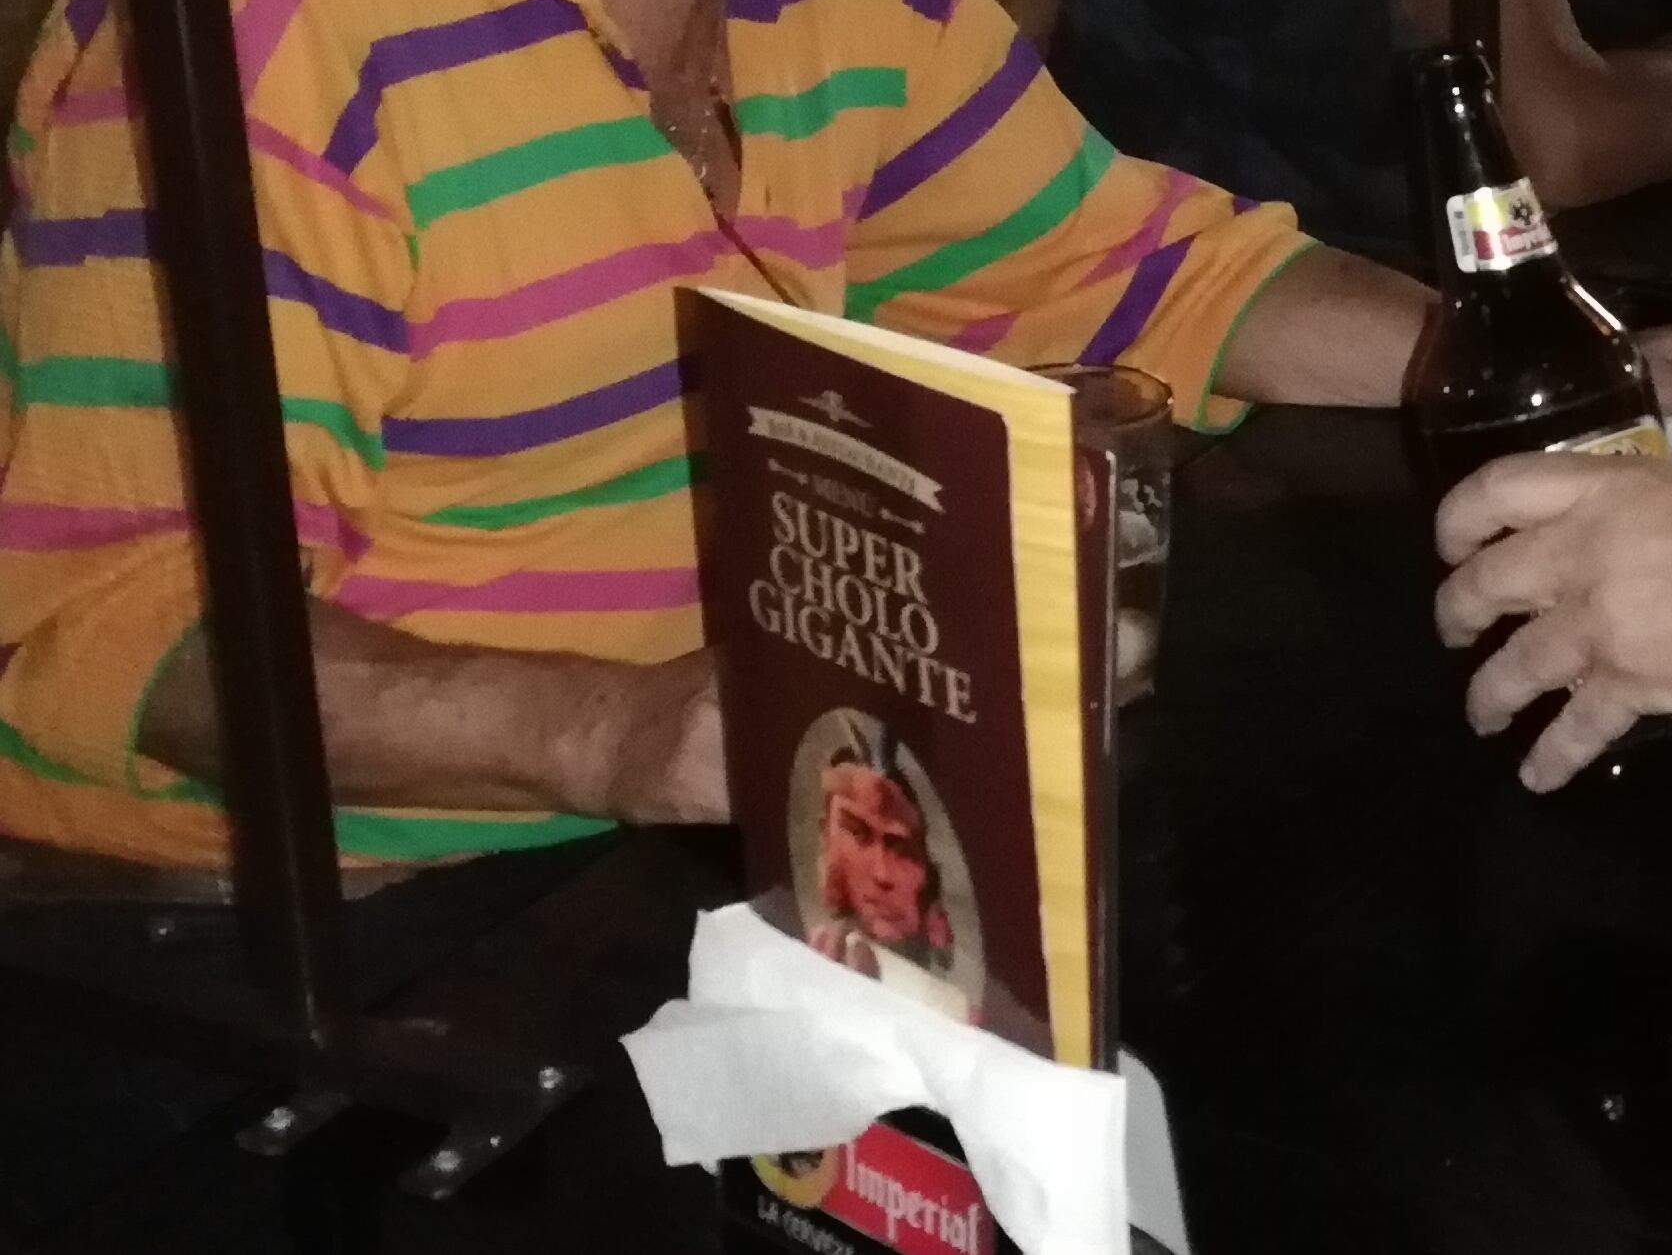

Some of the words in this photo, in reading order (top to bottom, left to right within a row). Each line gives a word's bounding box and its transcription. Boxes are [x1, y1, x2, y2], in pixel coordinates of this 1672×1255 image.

[769, 545, 938, 654] CHOLO
[770, 491, 926, 606] SUPER
[748, 579, 977, 724] GIGANTE
[845, 1143, 982, 1255] Imperial
